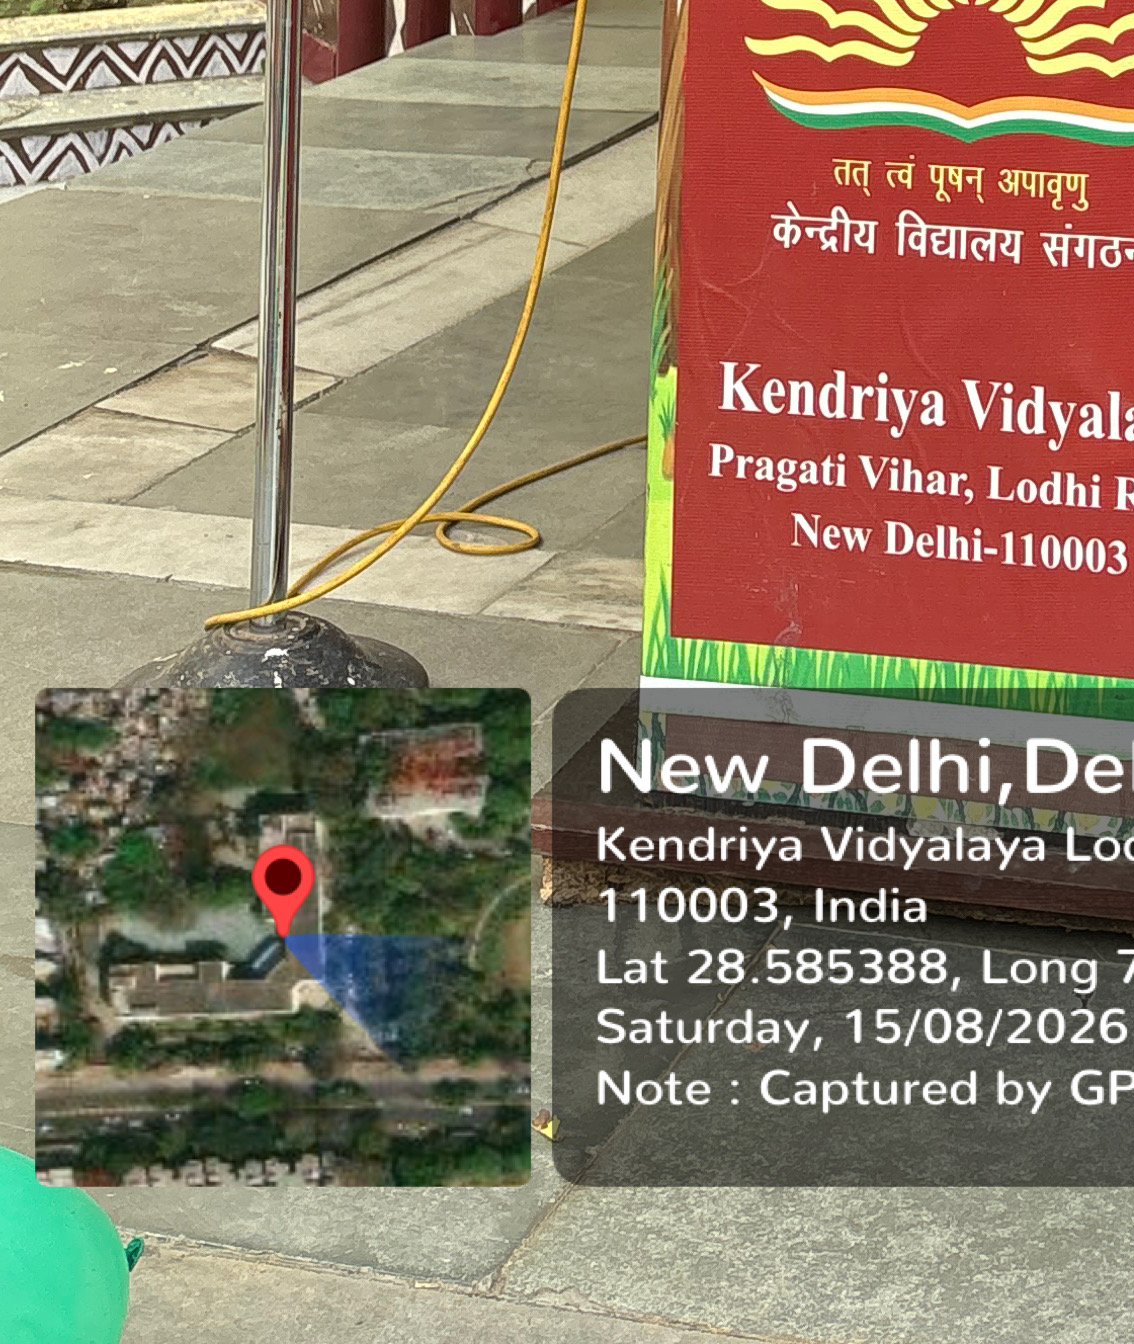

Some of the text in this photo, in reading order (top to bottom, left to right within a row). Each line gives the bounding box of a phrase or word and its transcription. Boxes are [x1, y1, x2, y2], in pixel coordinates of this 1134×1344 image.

[832, 154, 1090, 212] तत् त्वं पूषन् अपावृणु
[770, 200, 879, 254] केन्द्रीय
[895, 209, 1024, 264] विद्यालय
[718, 361, 946, 439] Kendriya
[708, 443, 846, 493] Pragati
[858, 455, 974, 505] Vihar,
[987, 465, 1101, 509] Lodhi
[791, 512, 1128, 575] New Delhi-110003
